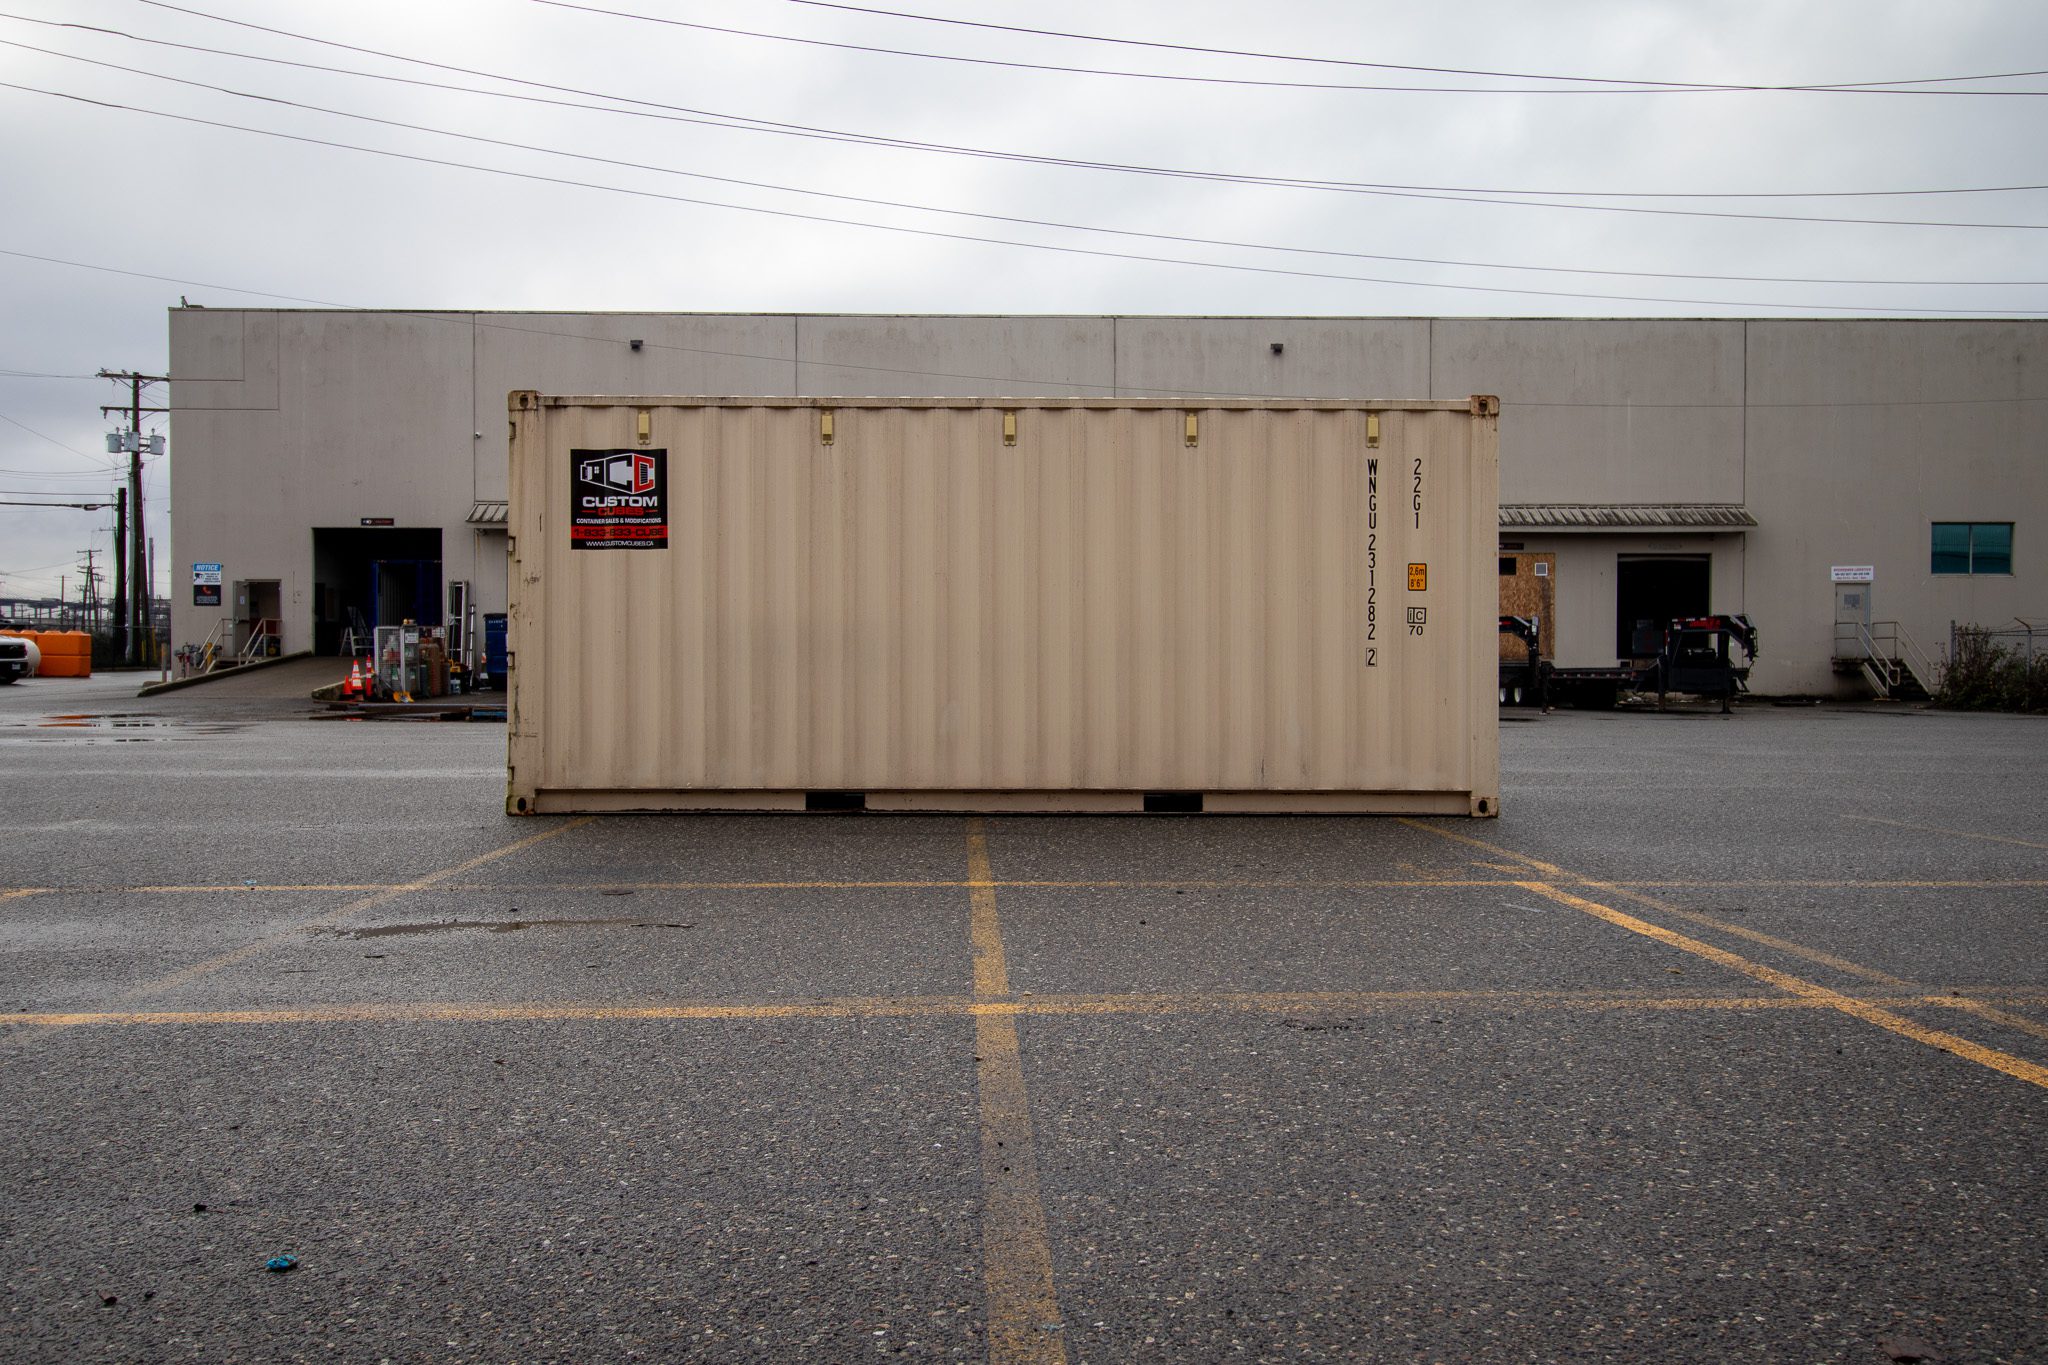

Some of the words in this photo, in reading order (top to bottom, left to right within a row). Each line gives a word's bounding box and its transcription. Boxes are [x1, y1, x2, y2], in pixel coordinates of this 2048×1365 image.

[1367, 458, 1378, 529] WNGU
[1413, 458, 1422, 529] 22G1
[582, 495, 658, 508] CUSTOM
[597, 506, 644, 516] CUBES
[576, 517, 605, 525] CONTAINER
[574, 527, 665, 537] 1-833-833-CUBE
[1367, 533, 1377, 640] 231282
[1408, 625, 1424, 636] 70
[1367, 648, 1376, 666] 2
